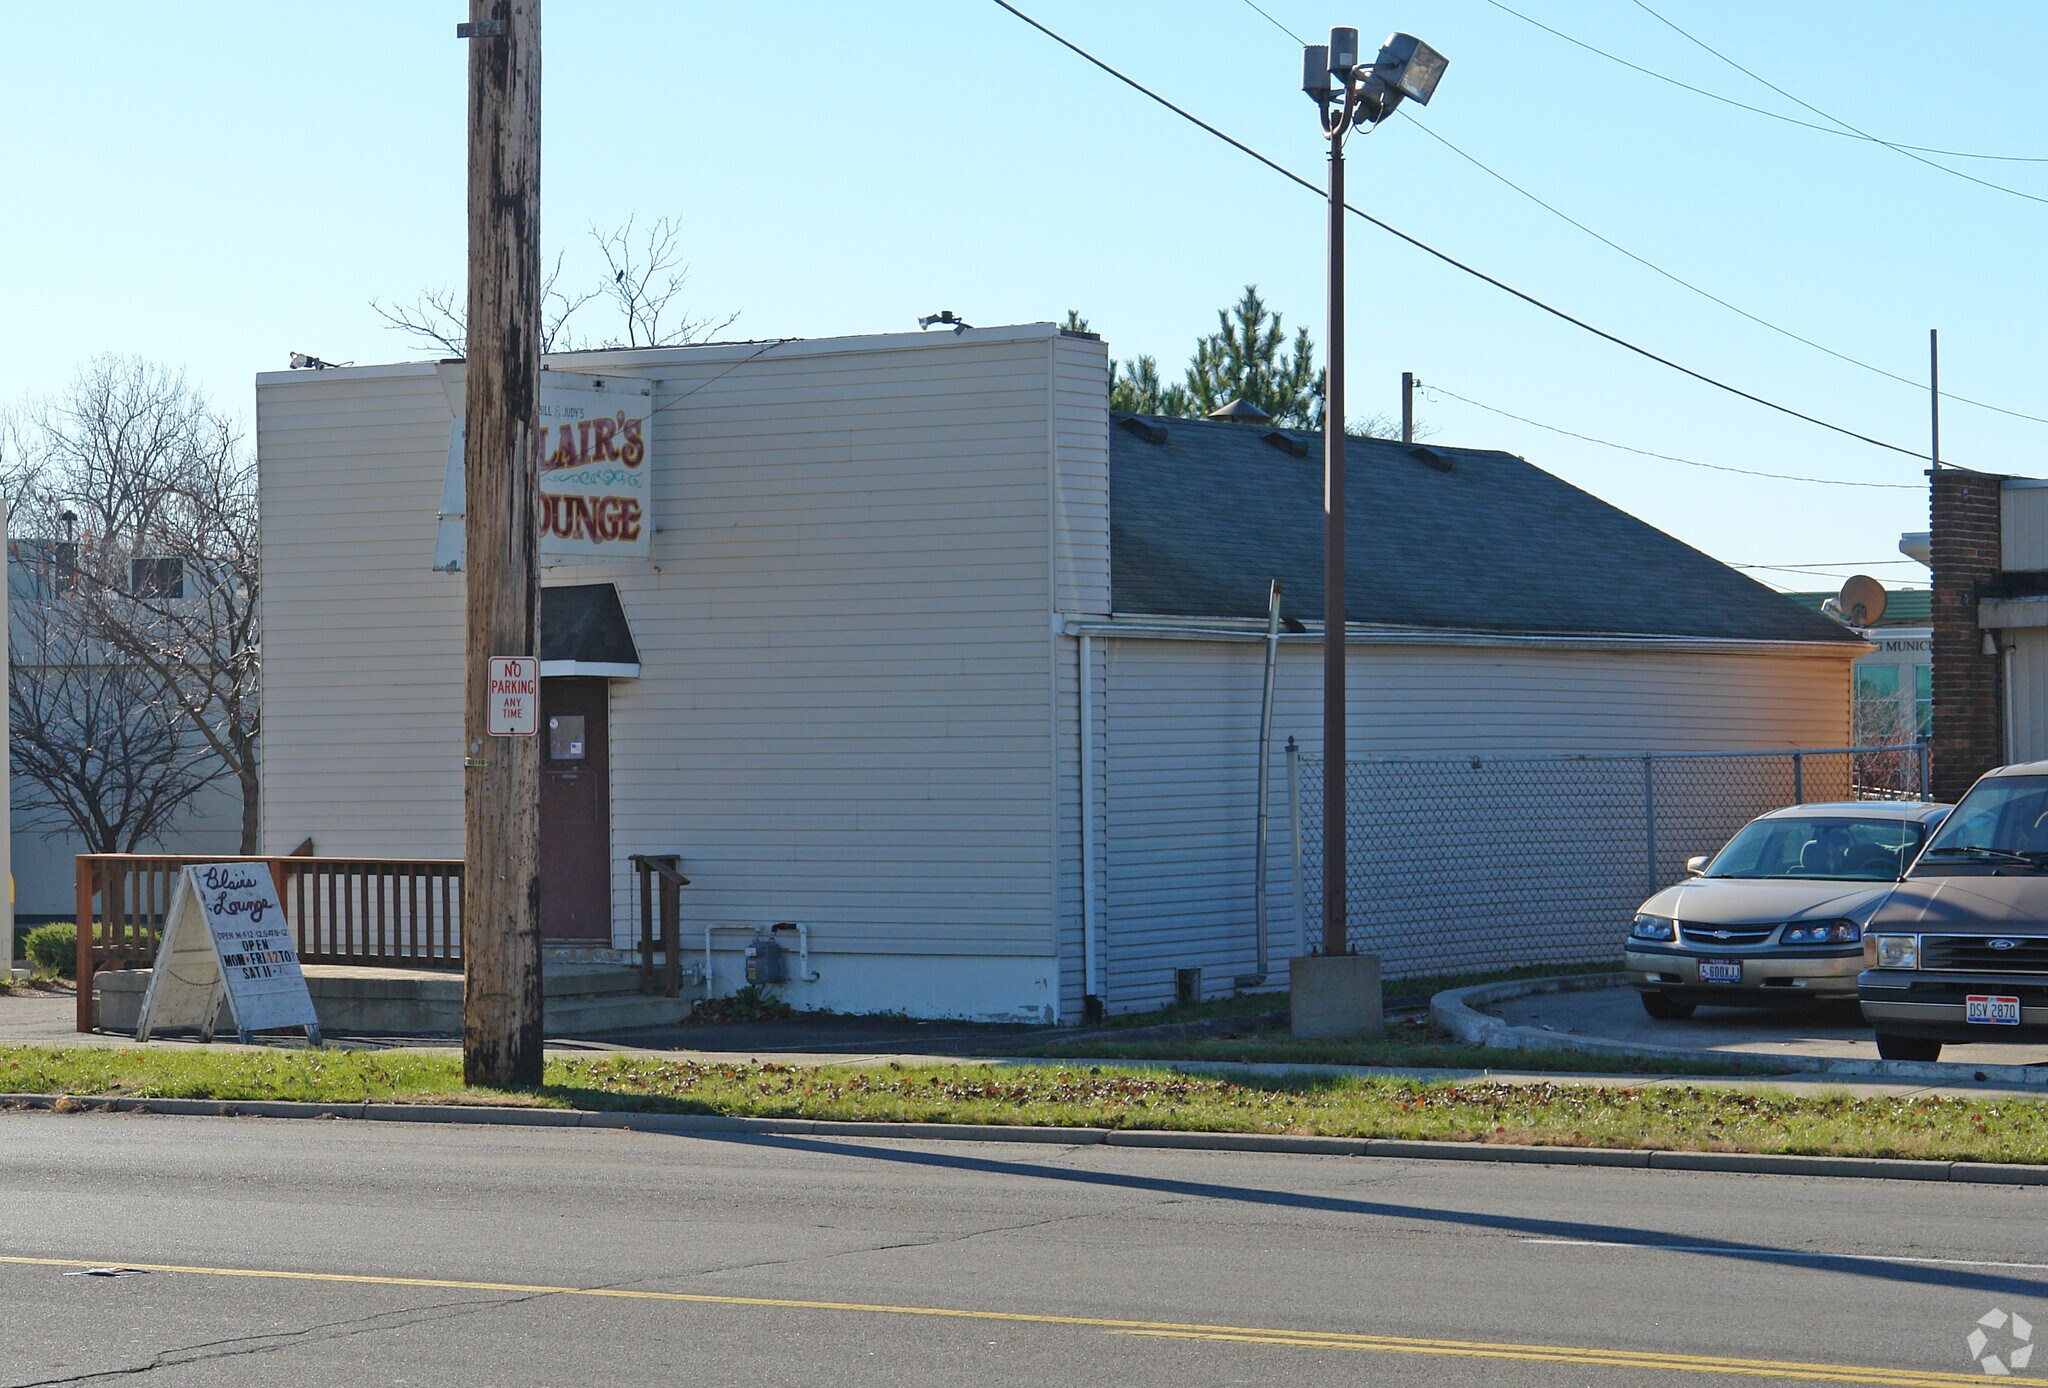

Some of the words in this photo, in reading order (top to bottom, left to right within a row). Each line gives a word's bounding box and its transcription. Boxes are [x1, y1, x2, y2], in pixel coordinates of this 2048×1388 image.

[554, 404, 561, 419] &
[562, 407, 585, 419] JUDY'S
[504, 663, 522, 677] NO
[491, 680, 534, 695] PARKING
[503, 698, 522, 708] ANY
[503, 708, 523, 718] TIME
[213, 891, 274, 922] Lounge
[217, 932, 234, 940] OPEN
[242, 939, 269, 951] OPEN
[267, 951, 280, 964] 12
[242, 967, 261, 980] SAT
[1991, 1004, 2016, 1019] 2870
